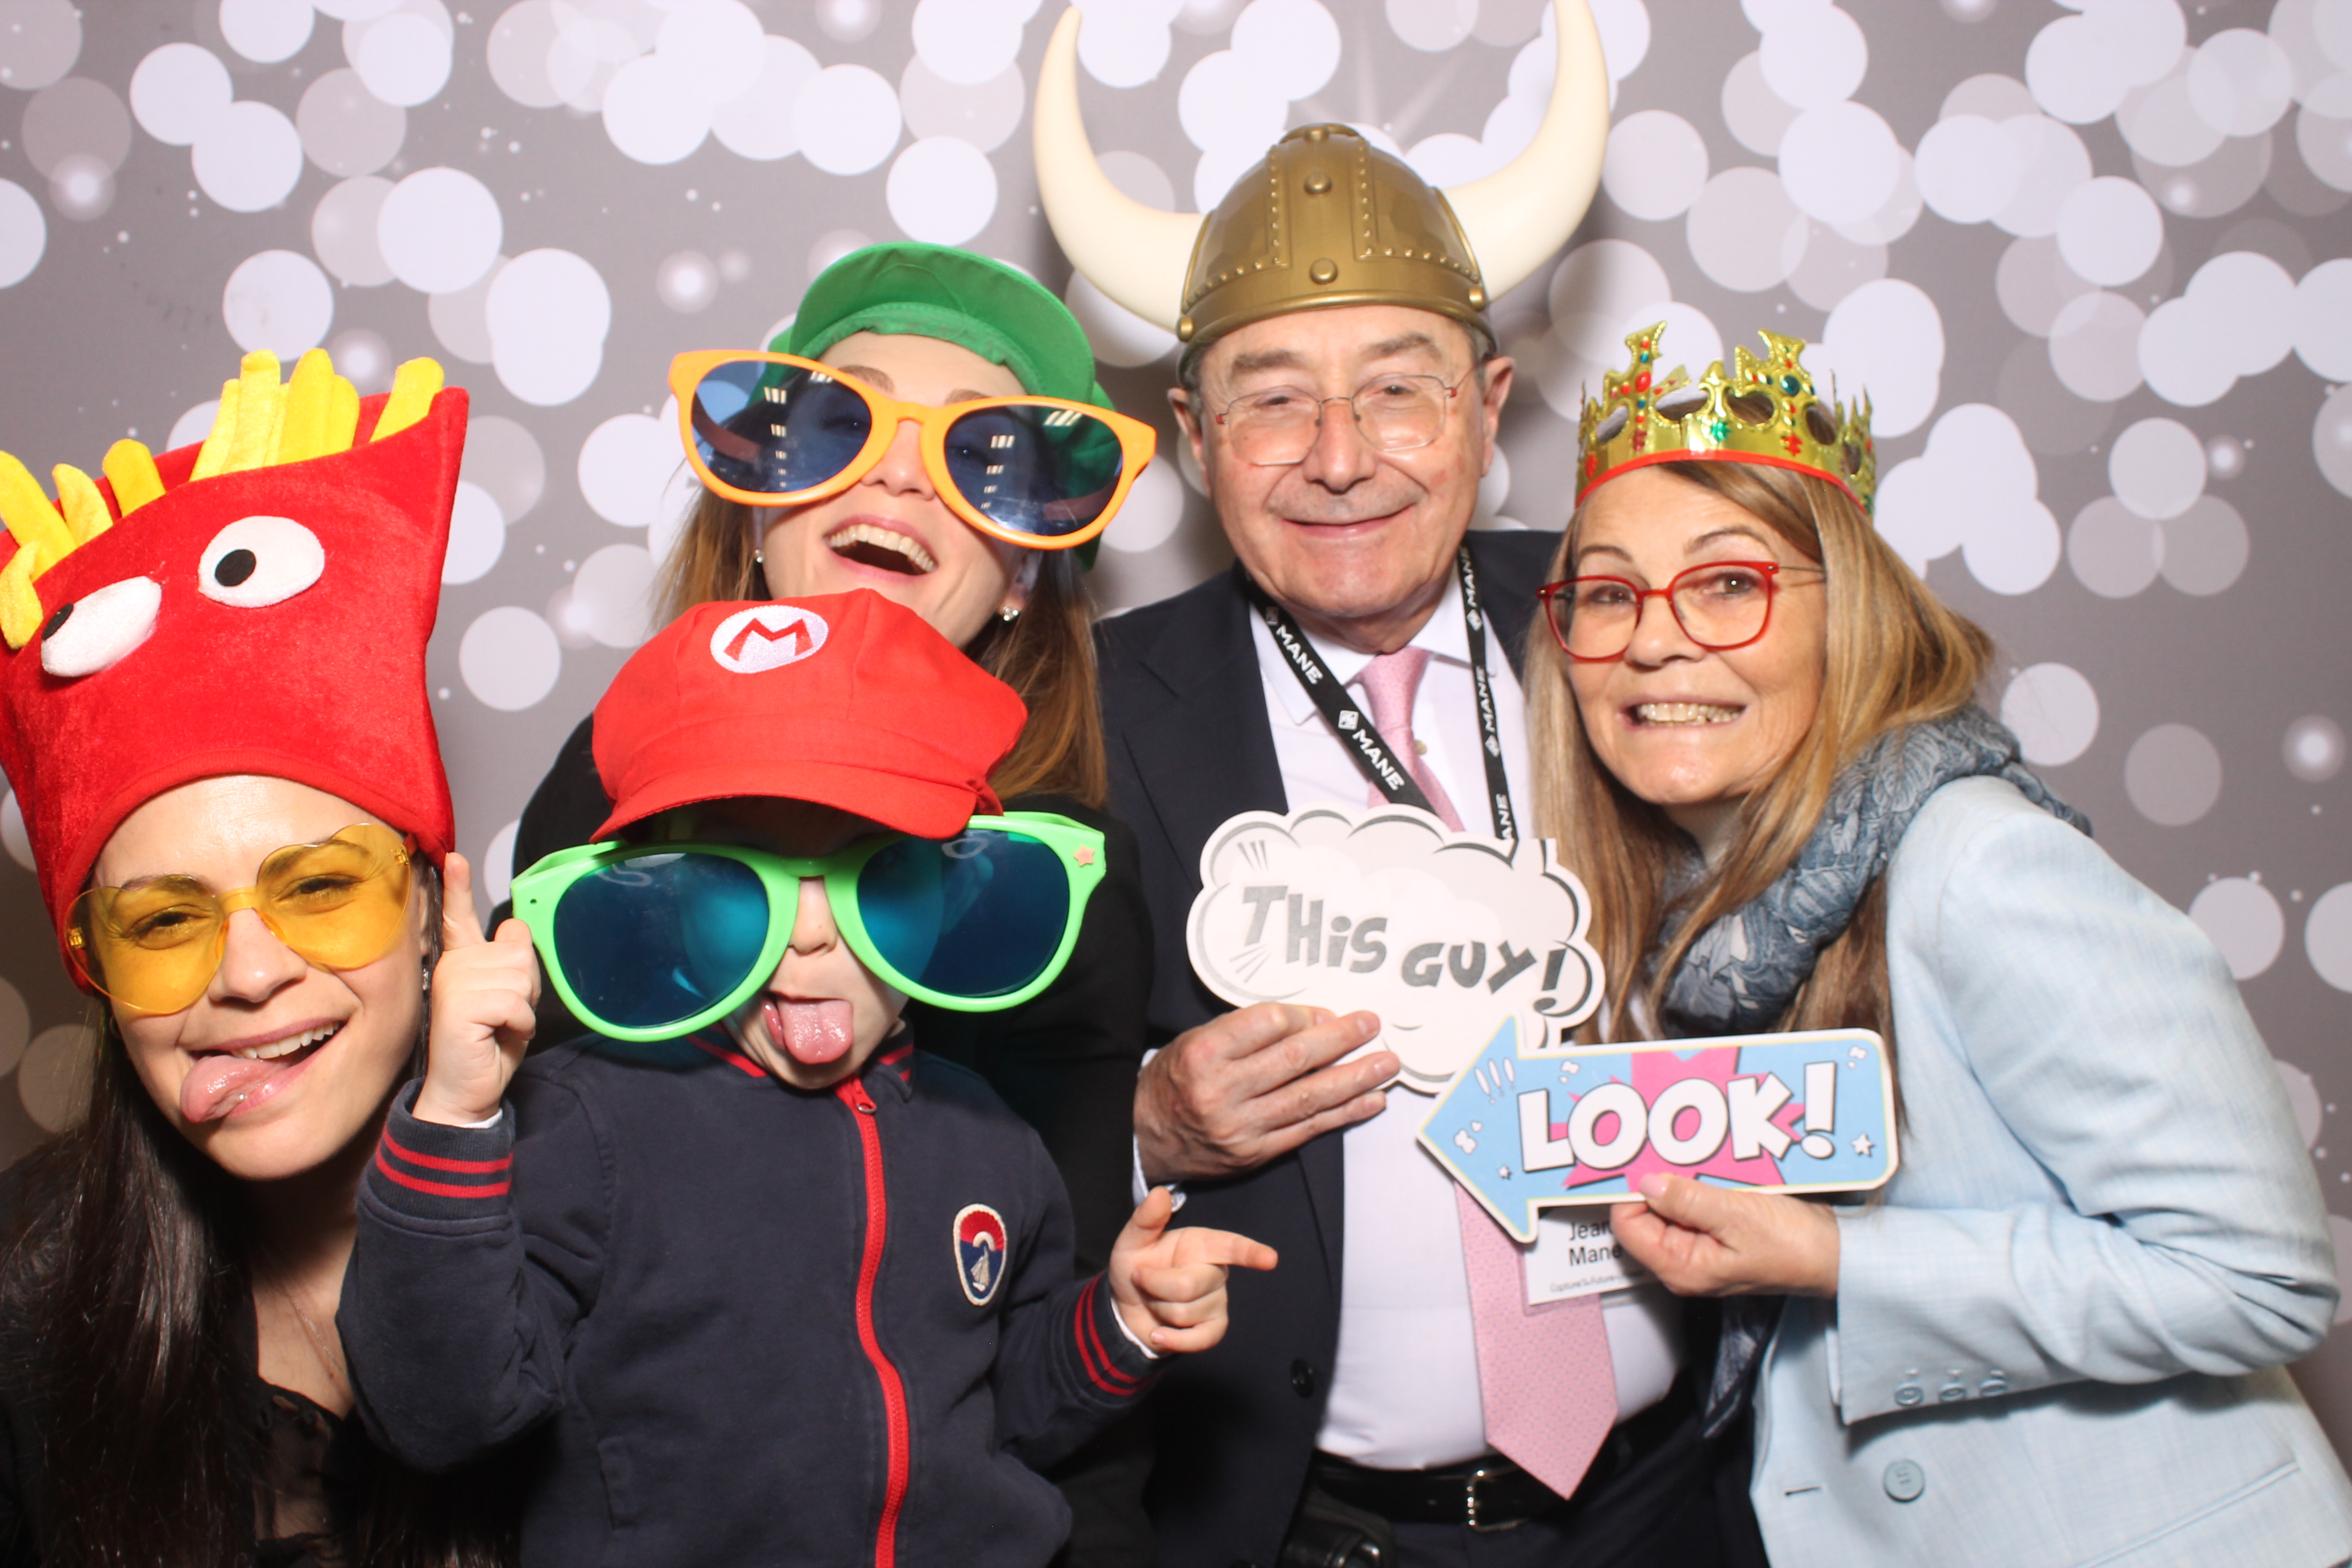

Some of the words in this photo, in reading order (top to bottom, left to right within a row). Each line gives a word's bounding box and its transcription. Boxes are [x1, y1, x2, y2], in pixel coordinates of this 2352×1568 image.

[723, 617, 814, 661] M
[1275, 624, 1323, 684] MANE
[1475, 666, 1496, 733] MANE
[1352, 728, 1405, 791] MANE
[1495, 793, 1513, 839] ANE
[1401, 939, 1567, 1012] GUY!
[1517, 1060, 1837, 1172] LOOK!
[1569, 1243, 1623, 1266] Mane
